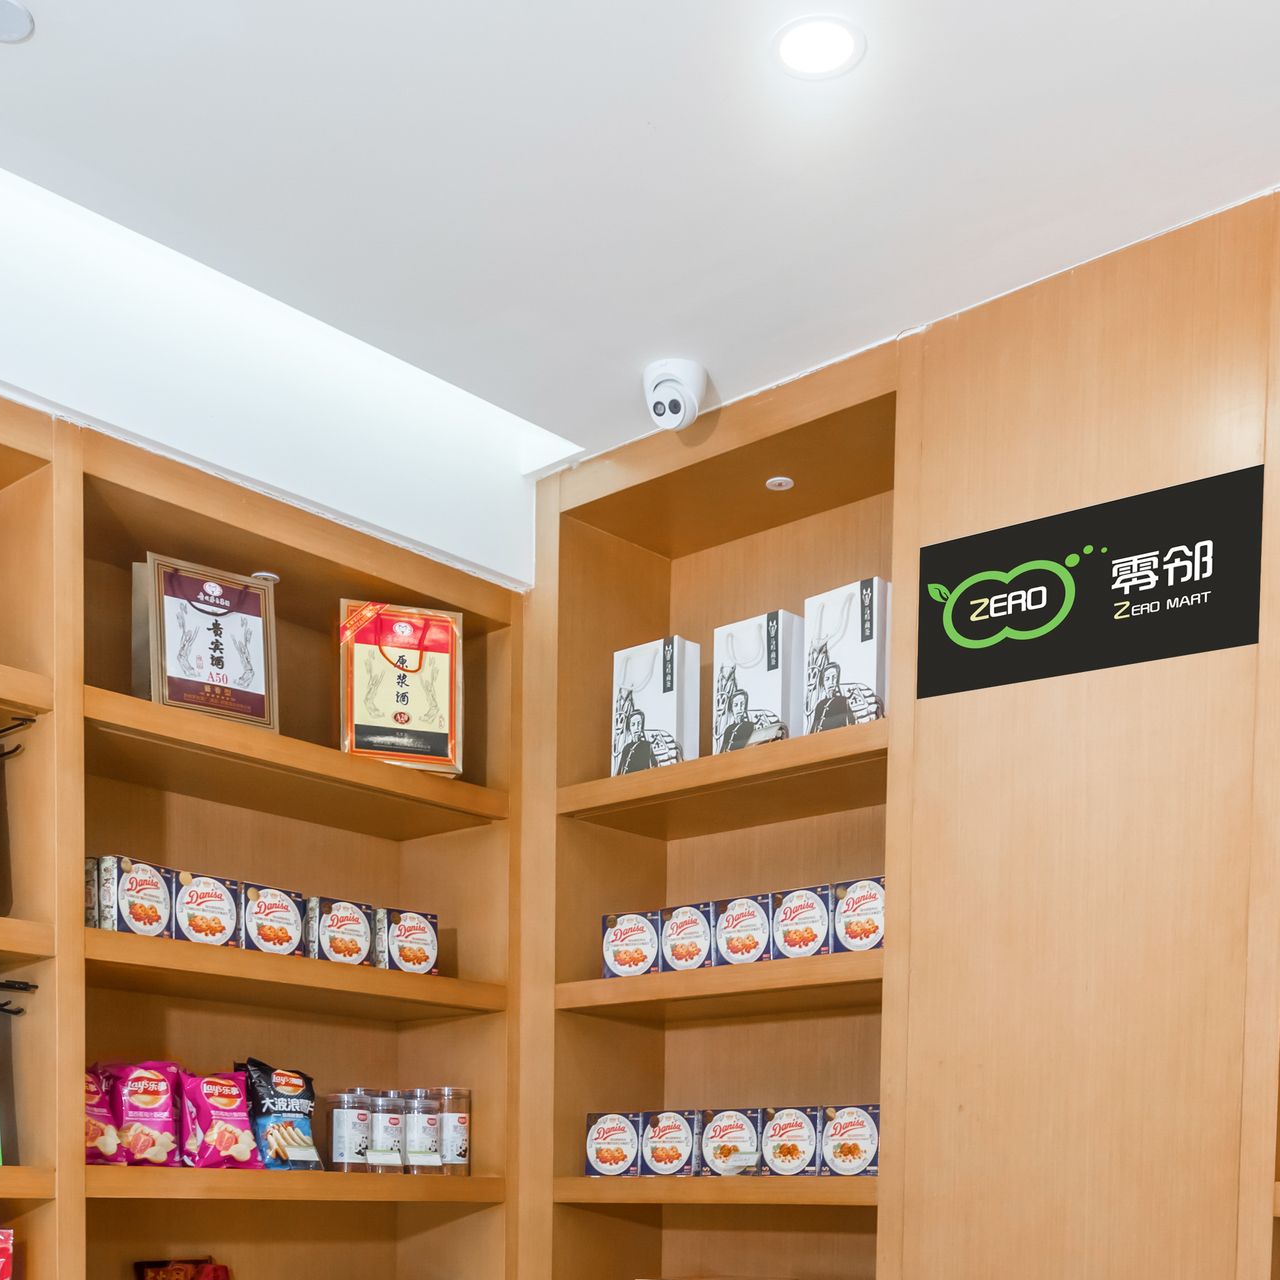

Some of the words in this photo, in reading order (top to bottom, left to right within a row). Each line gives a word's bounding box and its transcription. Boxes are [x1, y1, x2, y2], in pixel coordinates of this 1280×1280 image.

[1111, 539, 1214, 595] 零邻
[970, 585, 1048, 622] ZERO
[1113, 600, 1161, 620] ZERO
[1166, 591, 1212, 611] MART
[207, 671, 229, 685] A50
[395, 654, 410, 706] 原浆酒
[127, 877, 161, 894] Danisa
[188, 890, 224, 908] Danisa
[256, 901, 290, 916] Danisa
[843, 890, 878, 913] Danisa
[723, 908, 757, 930] Danisa
[781, 900, 815, 923] Danisa
[330, 913, 361, 931] Danisa
[397, 923, 428, 941] Danisa
[669, 917, 700, 938] Danisa
[613, 923, 645, 942] Danisa
[596, 1120, 627, 1140] Danisa
[650, 1120, 682, 1140] Danisa
[710, 1121, 744, 1140] Danisa
[772, 1120, 805, 1139] Danisa
[832, 1118, 866, 1138] Danisa
